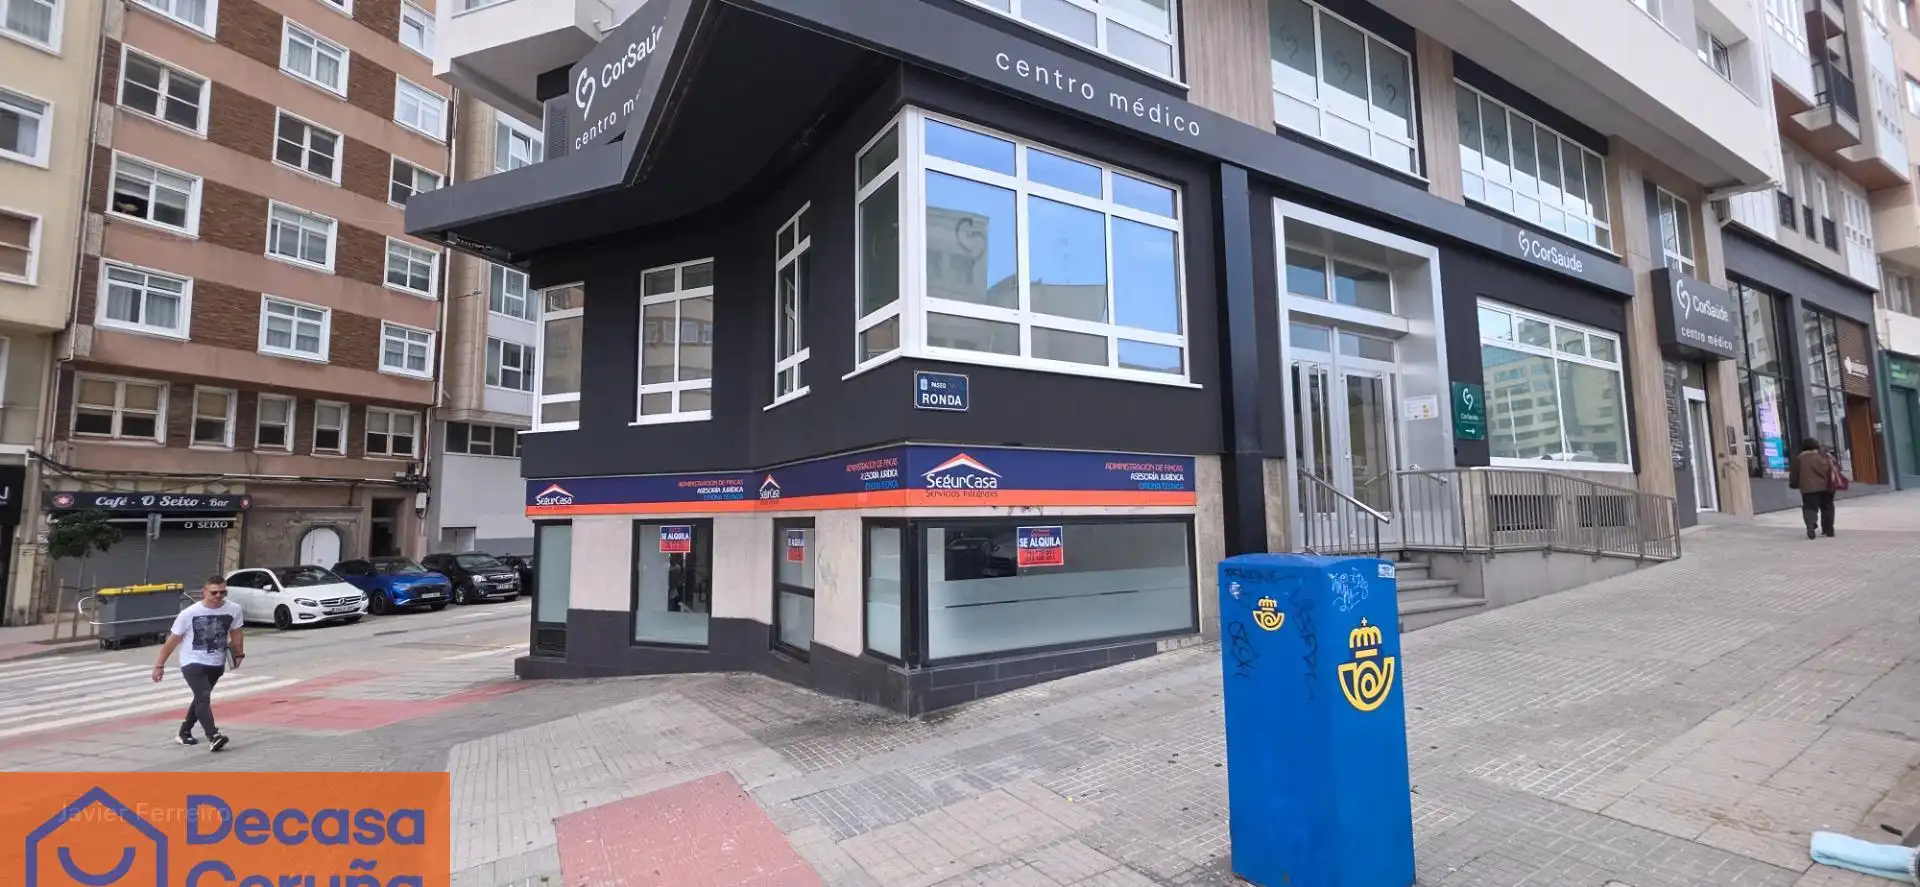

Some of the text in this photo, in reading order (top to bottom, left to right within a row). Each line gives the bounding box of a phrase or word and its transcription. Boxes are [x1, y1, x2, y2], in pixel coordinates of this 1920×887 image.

[995, 52, 1201, 137] centro médico
[575, 112, 617, 150] centro
[1532, 240, 1583, 273] CorSaúde
[1693, 295, 1729, 322] CorSaúde
[1681, 326, 1733, 351] centro médico
[922, 393, 962, 406] RONDA
[926, 473, 998, 489] SegurCasa
[1130, 472, 1159, 481] ASESORÍA
[95, 496, 128, 508] Café
[141, 495, 156, 506] O
[159, 495, 200, 506] Seixo
[209, 498, 230, 507] Bar
[184, 520, 229, 529] O SEIXO
[1020, 536, 1061, 548] SE ALQUILA
